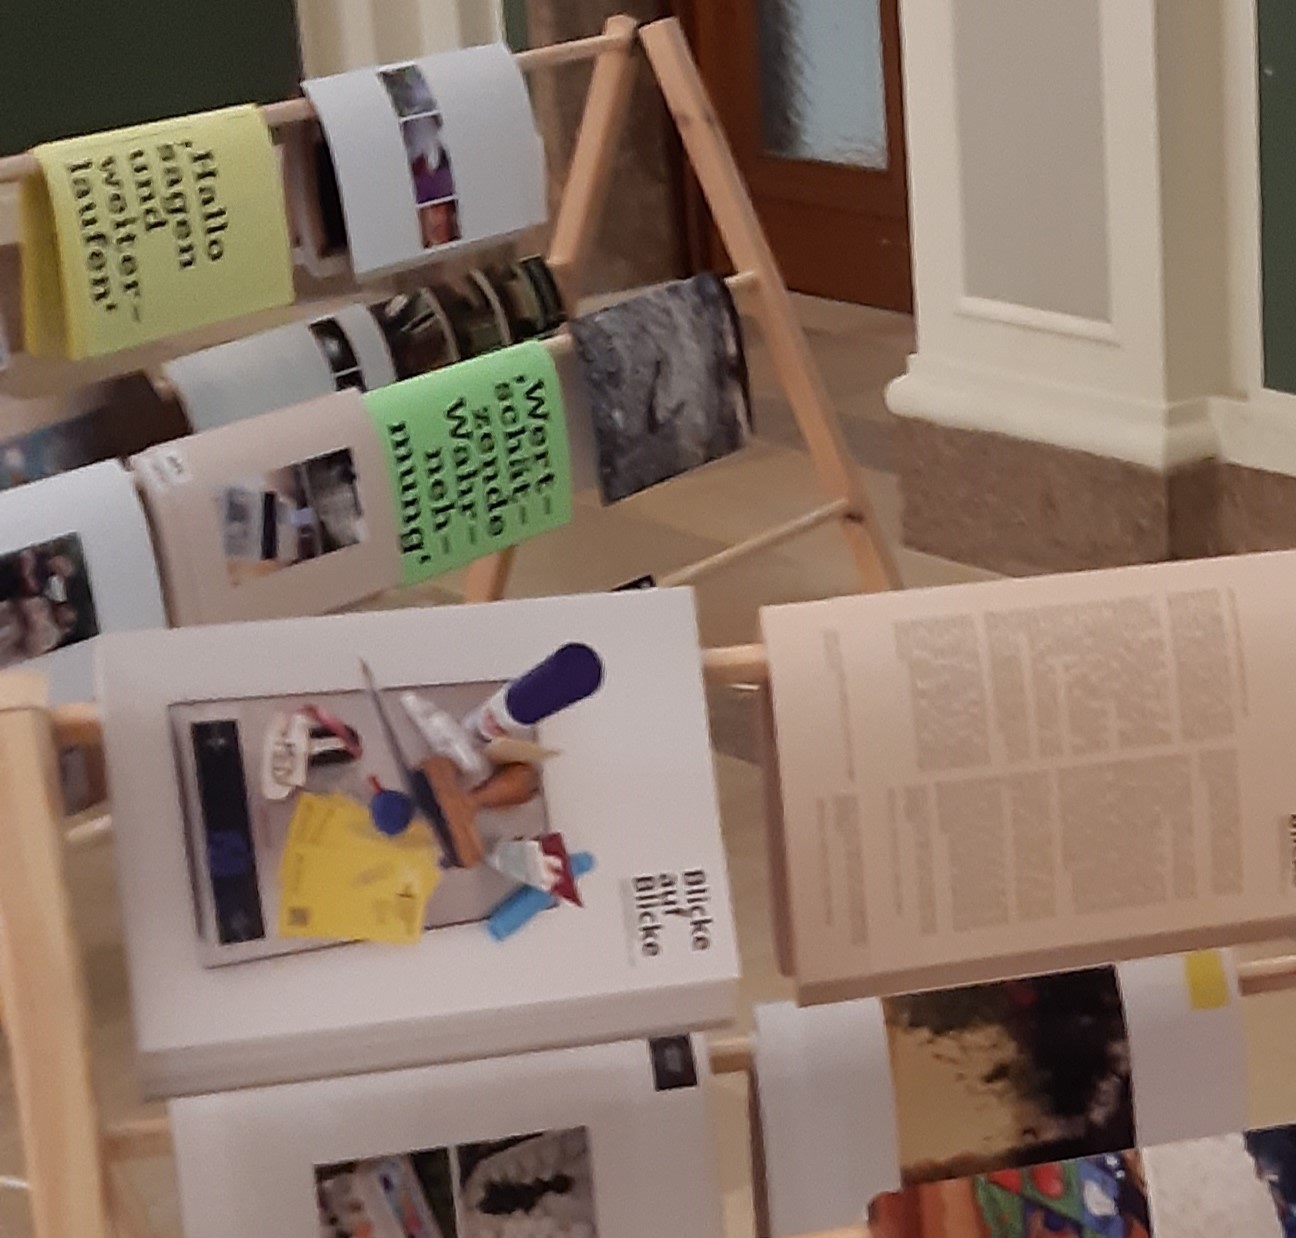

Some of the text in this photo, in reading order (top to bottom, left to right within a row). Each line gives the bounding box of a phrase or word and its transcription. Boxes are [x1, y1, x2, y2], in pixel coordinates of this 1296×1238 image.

[99, 156, 141, 322] weiter-
[130, 150, 169, 231] und
[158, 144, 196, 269] sagen
[424, 447, 456, 554] neh-
[446, 398, 480, 546] Wahr-
[472, 407, 509, 537] zende
[634, 876, 662, 956] Blicke
[659, 874, 693, 916] auf
[684, 870, 713, 951] Blicke
